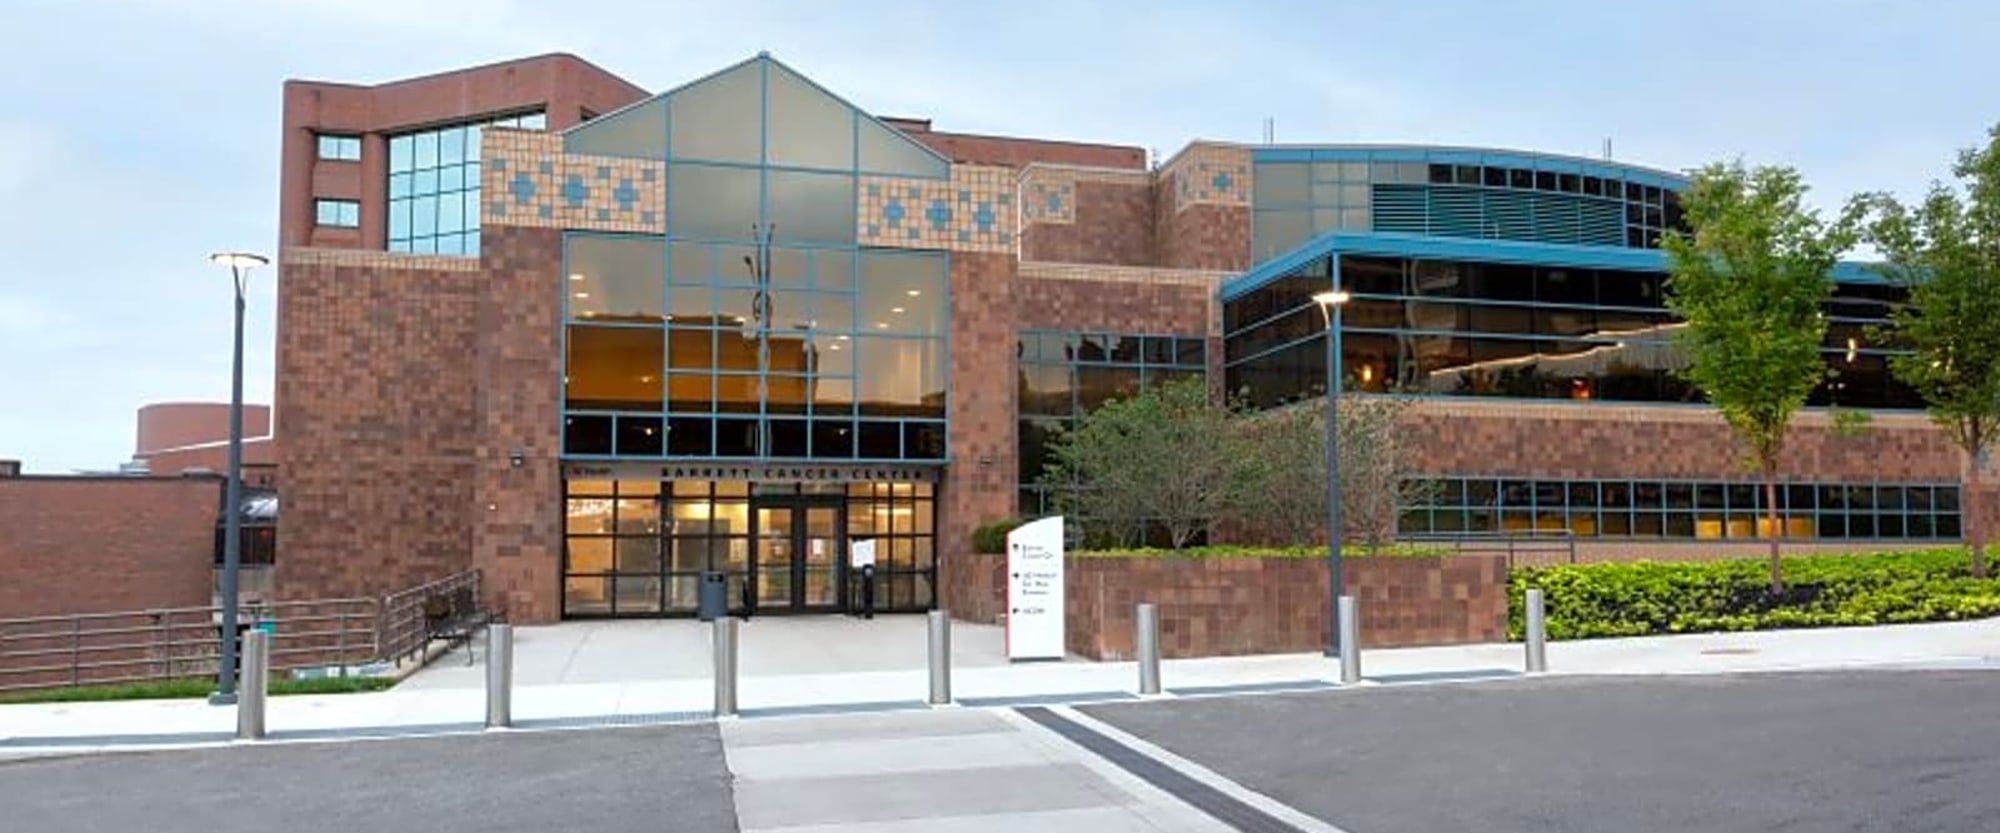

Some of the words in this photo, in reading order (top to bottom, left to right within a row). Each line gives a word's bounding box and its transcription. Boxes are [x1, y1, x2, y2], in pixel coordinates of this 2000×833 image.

[661, 467, 750, 478] BARRETT
[764, 468, 839, 479] CANCER
[852, 469, 923, 480] CENTER
